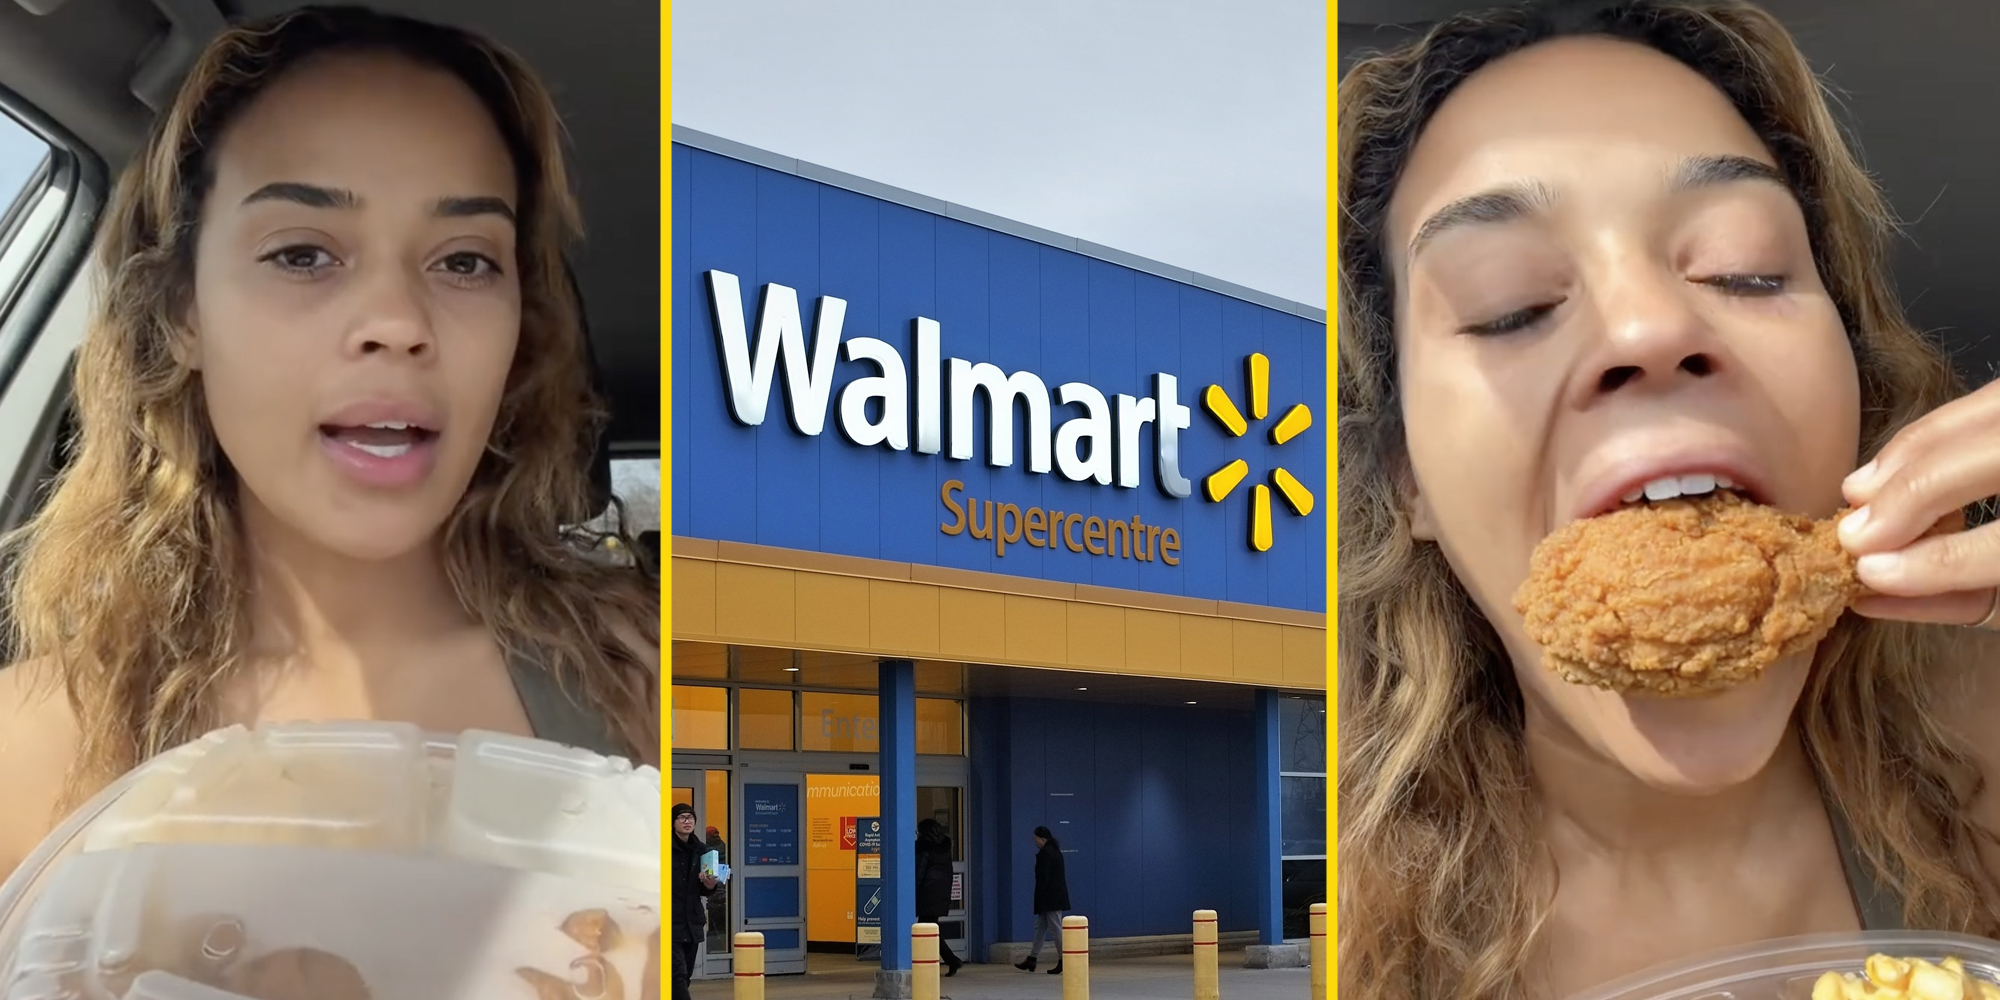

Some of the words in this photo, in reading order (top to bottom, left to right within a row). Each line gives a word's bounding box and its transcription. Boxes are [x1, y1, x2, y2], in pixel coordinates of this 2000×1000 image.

[705, 269, 1192, 498] Walmart
[941, 480, 1181, 566] Supercentre
[755, 803, 778, 811] Walmart
